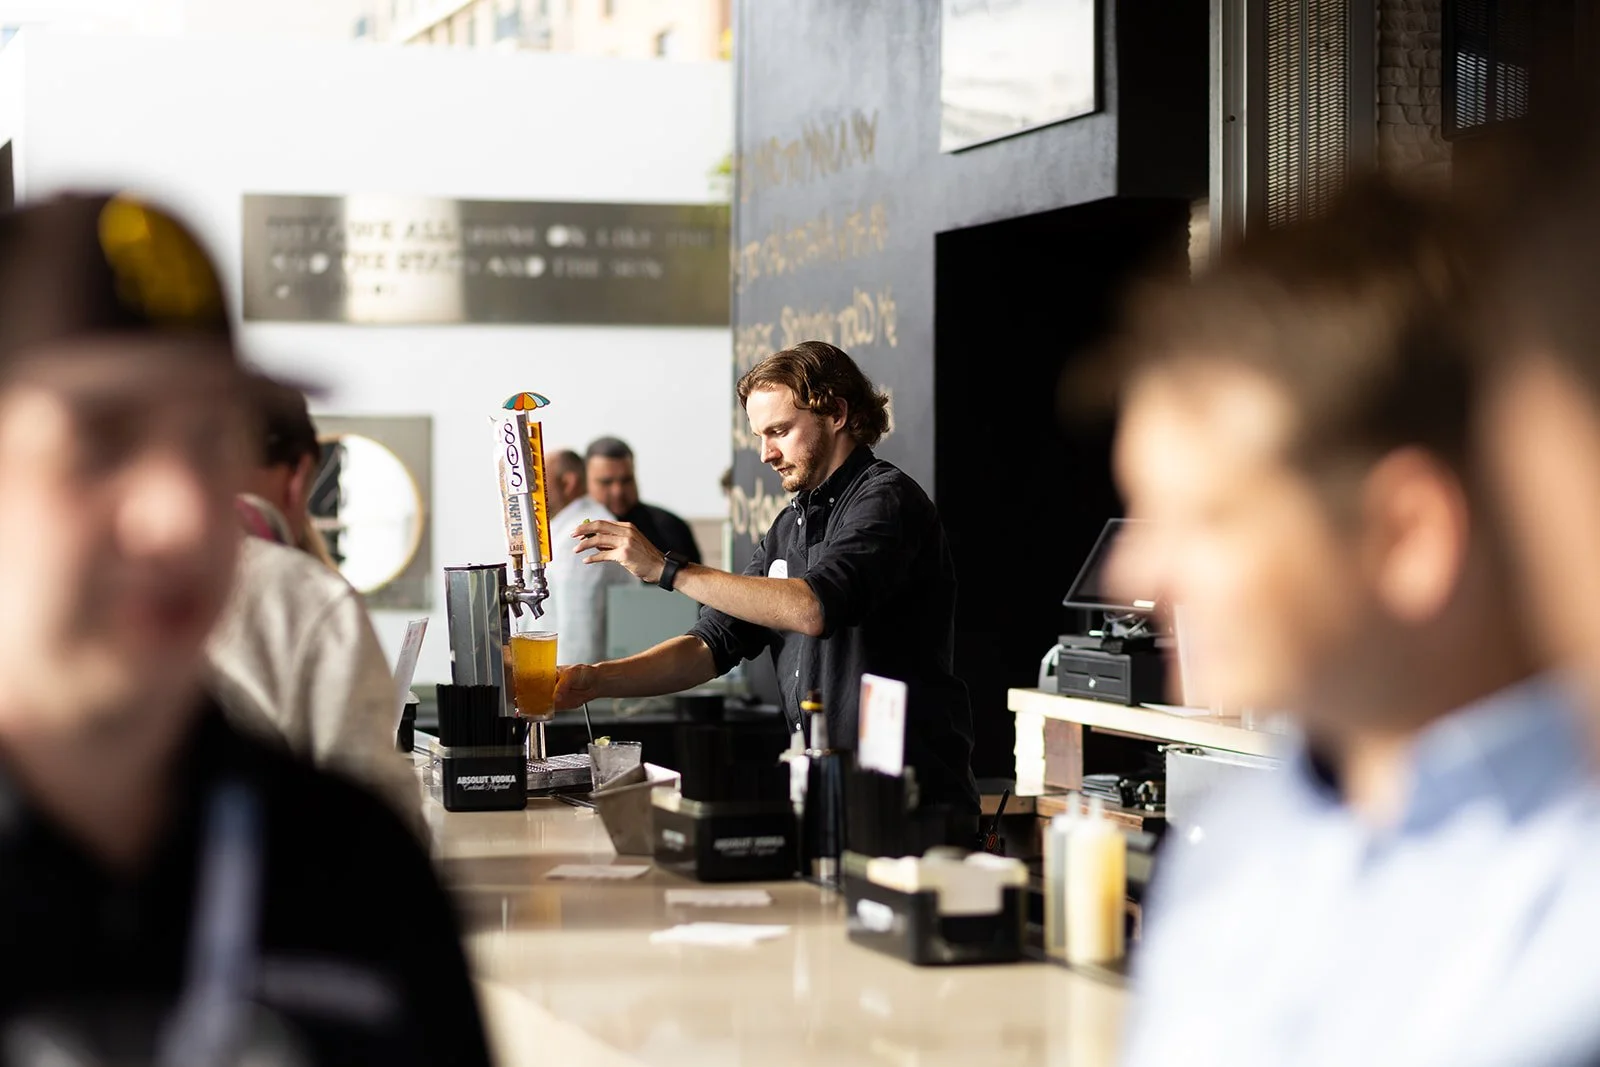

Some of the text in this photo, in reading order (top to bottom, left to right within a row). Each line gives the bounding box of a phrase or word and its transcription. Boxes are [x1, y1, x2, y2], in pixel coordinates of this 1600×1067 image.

[504, 422, 523, 488] 805
[509, 544, 524, 552] LAGE
[457, 775, 516, 784] ABSOLUT VODKA
